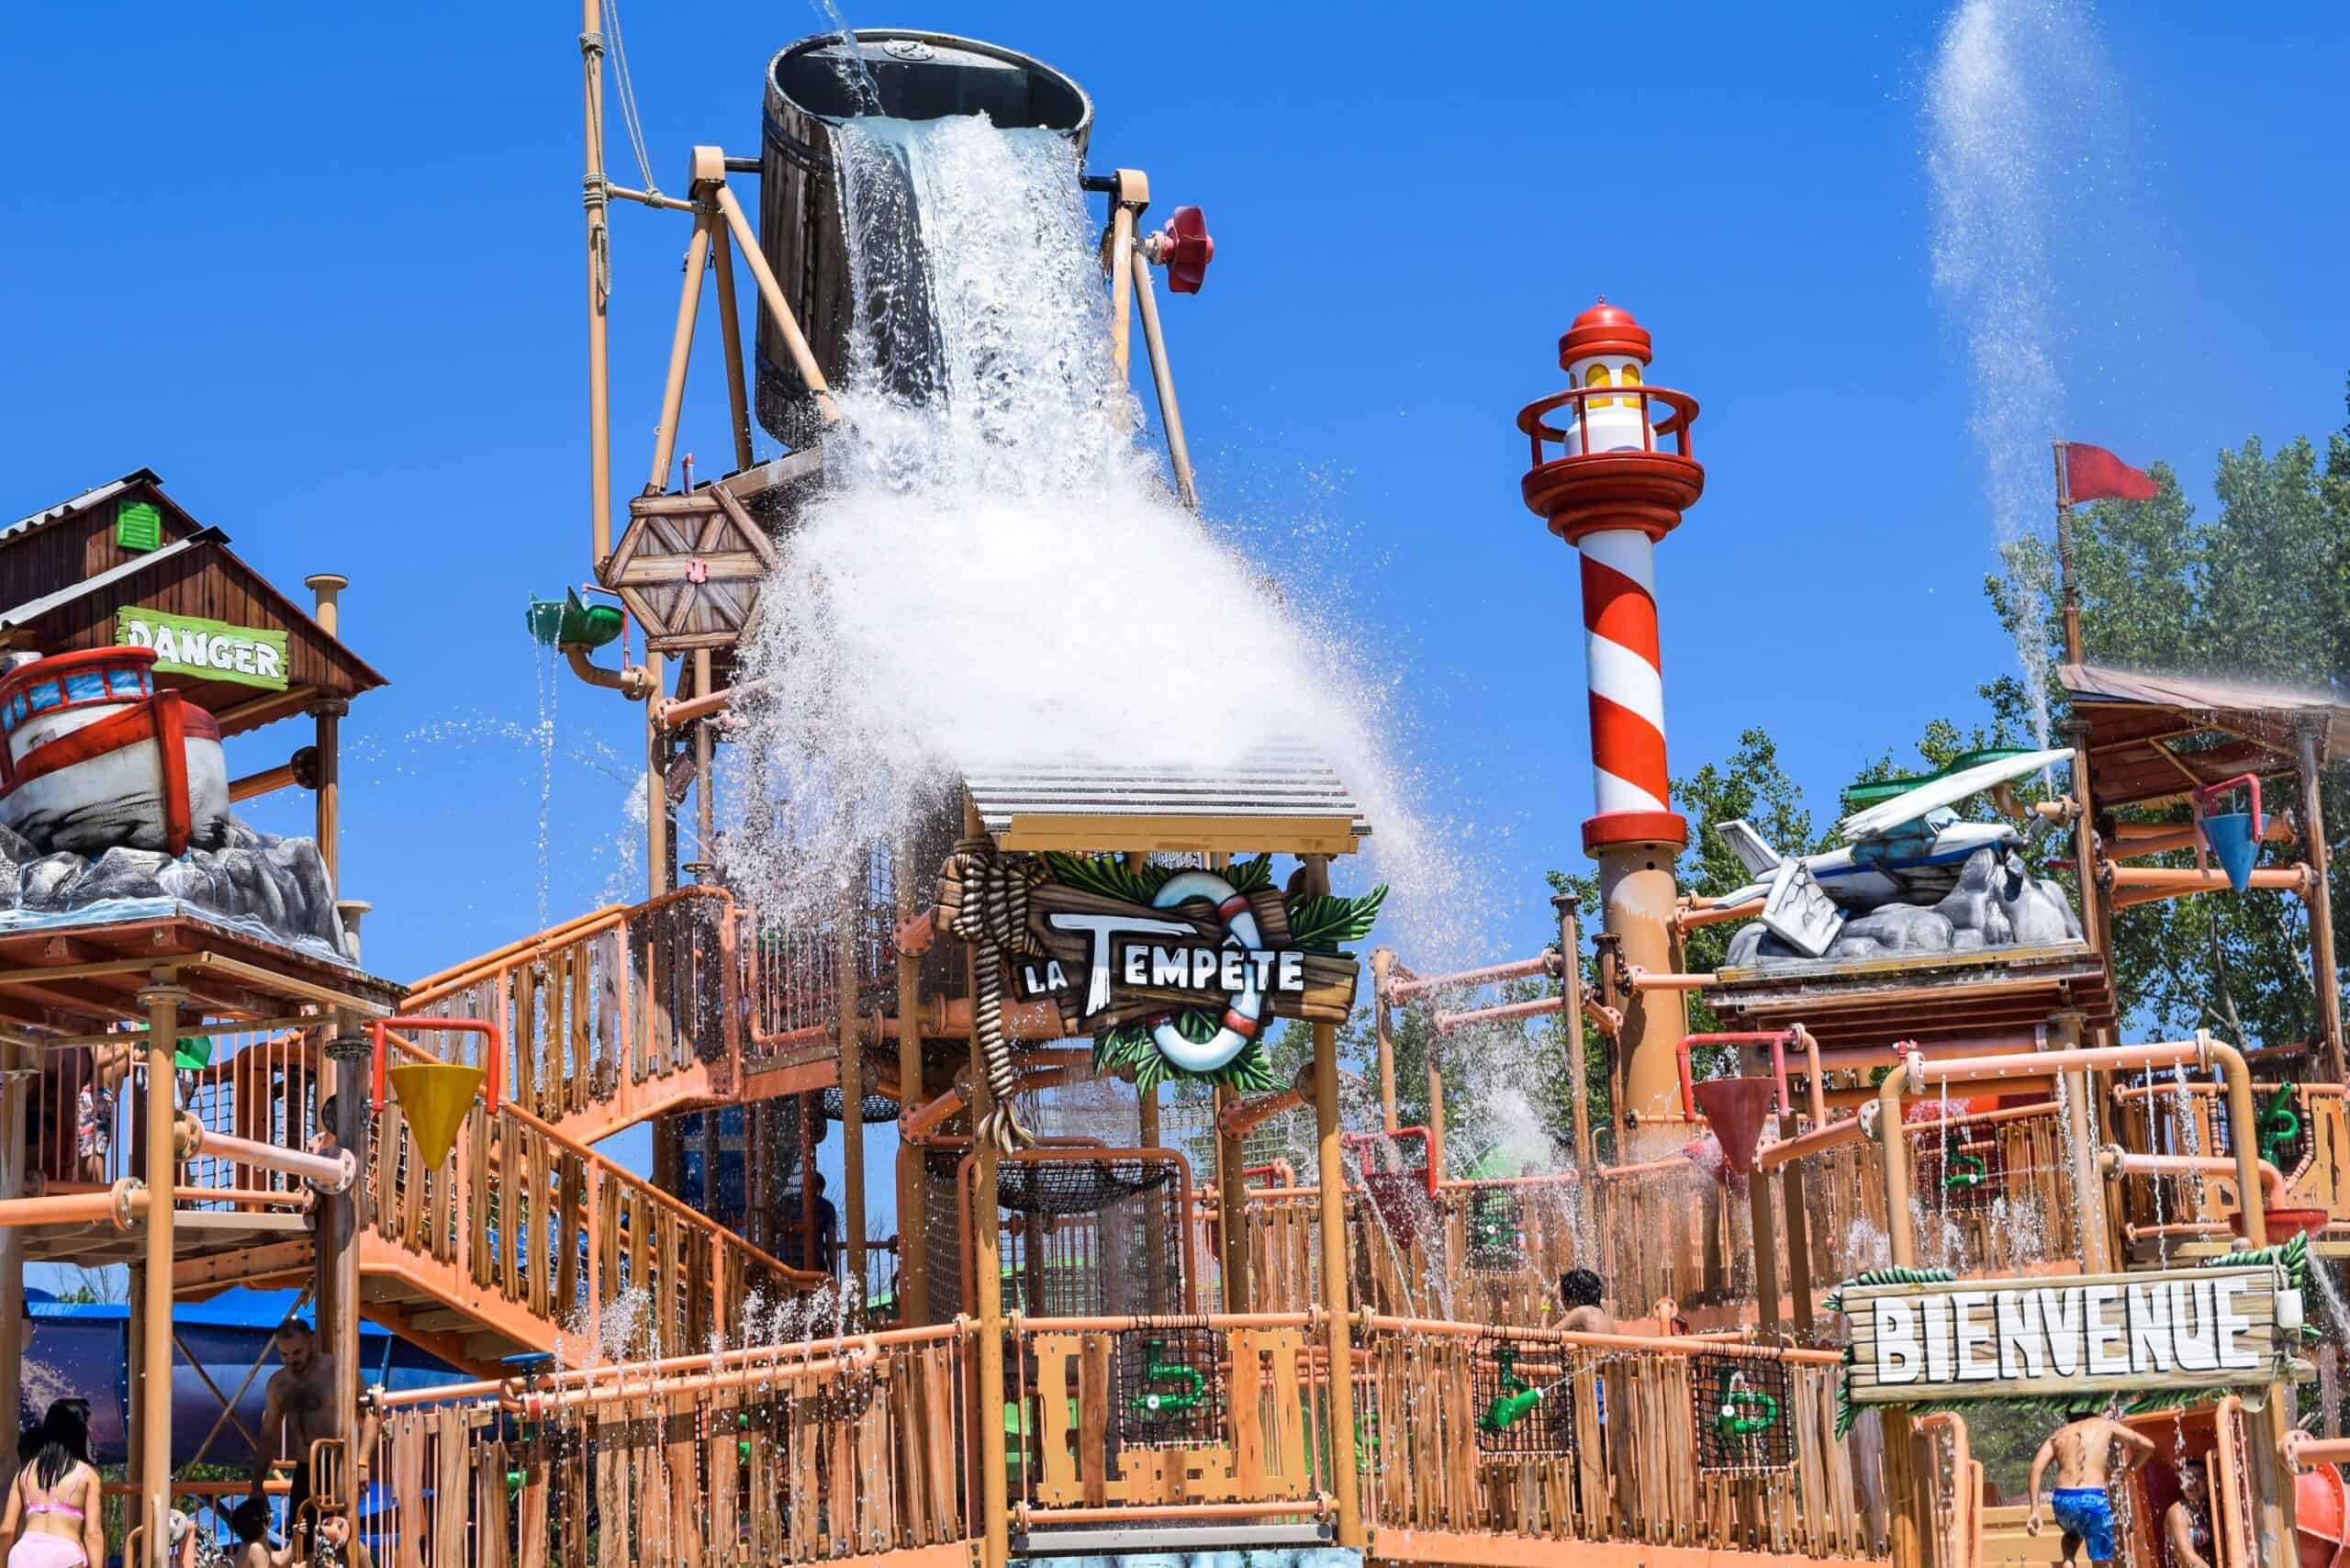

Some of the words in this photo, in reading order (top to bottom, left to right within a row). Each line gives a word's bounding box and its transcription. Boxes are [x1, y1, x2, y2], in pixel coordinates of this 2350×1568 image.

[128, 620, 280, 678] DANGER
[1024, 959, 1068, 994] LA
[1049, 913, 1305, 1017] TEMPÊTE
[1874, 1277, 2260, 1383] BIENVENUE
